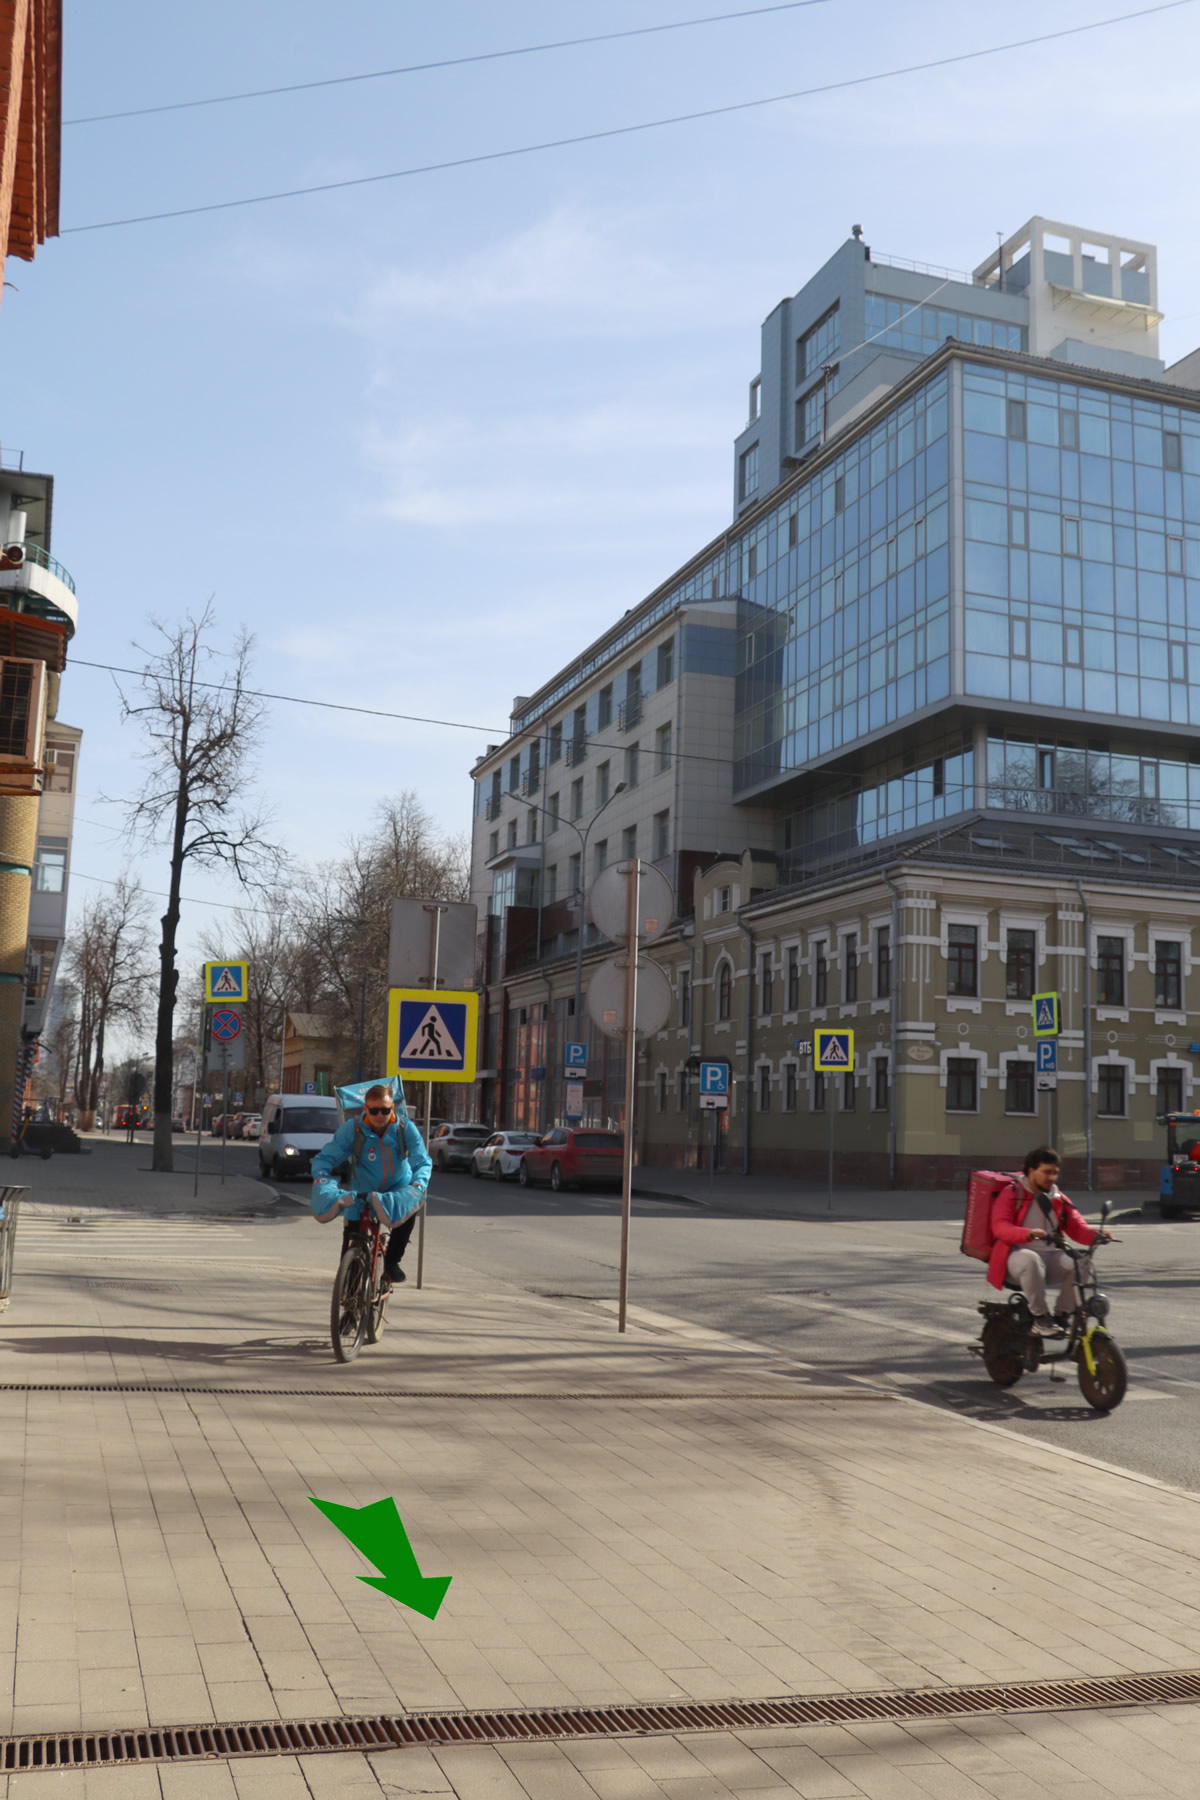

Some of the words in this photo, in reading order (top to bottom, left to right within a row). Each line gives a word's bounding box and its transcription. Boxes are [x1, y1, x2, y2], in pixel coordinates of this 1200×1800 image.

[569, 1045, 583, 1064] P
[799, 1041, 812, 1055] ВТБ
[1040, 1043, 1053, 1069] P
[707, 1066, 722, 1089] P
